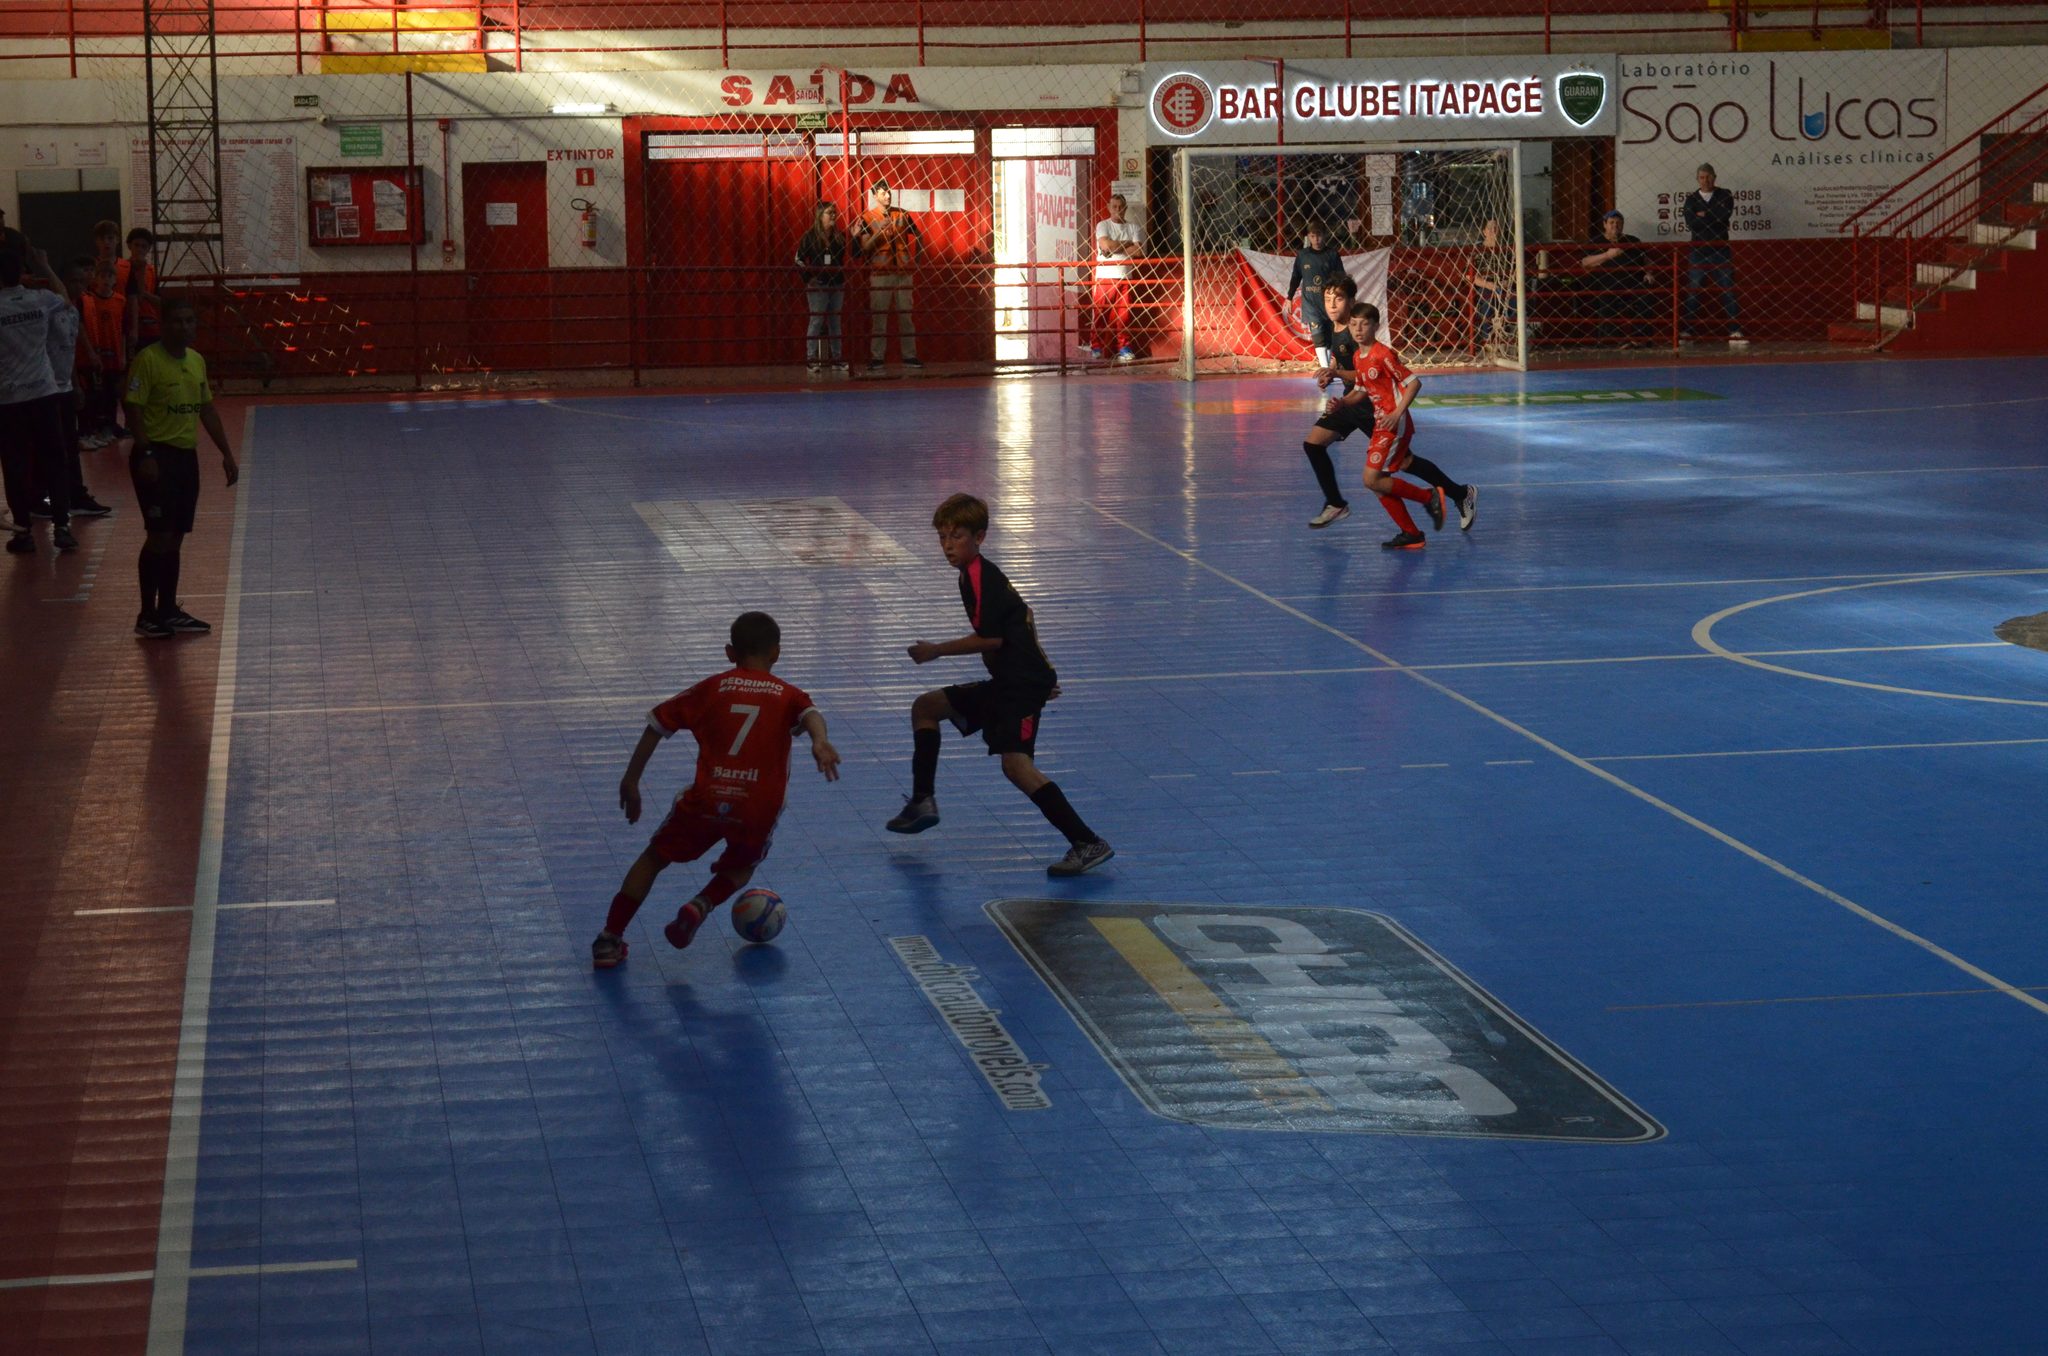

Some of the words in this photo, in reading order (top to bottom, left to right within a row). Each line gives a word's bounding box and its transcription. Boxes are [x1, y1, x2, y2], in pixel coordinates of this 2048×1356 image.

[1622, 60, 1750, 78] Laboratório
[1219, 84, 1281, 120] BAR
[1295, 83, 1401, 118] CLUBE
[1410, 74, 1543, 116] ITAPAGÉ
[1564, 85, 1599, 97] GUARANI
[1622, 84, 1748, 144] São
[547, 148, 614, 161] EXTINTOR
[1771, 151, 1854, 167] Análises
[1860, 148, 1935, 165] clínicas
[1036, 185, 1076, 230] PANAFÉ
[719, 676, 784, 691] PEDRINHO
[728, 703, 761, 756] 7
[712, 766, 759, 782] Barril
[1153, 913, 1519, 1116] CHICO
